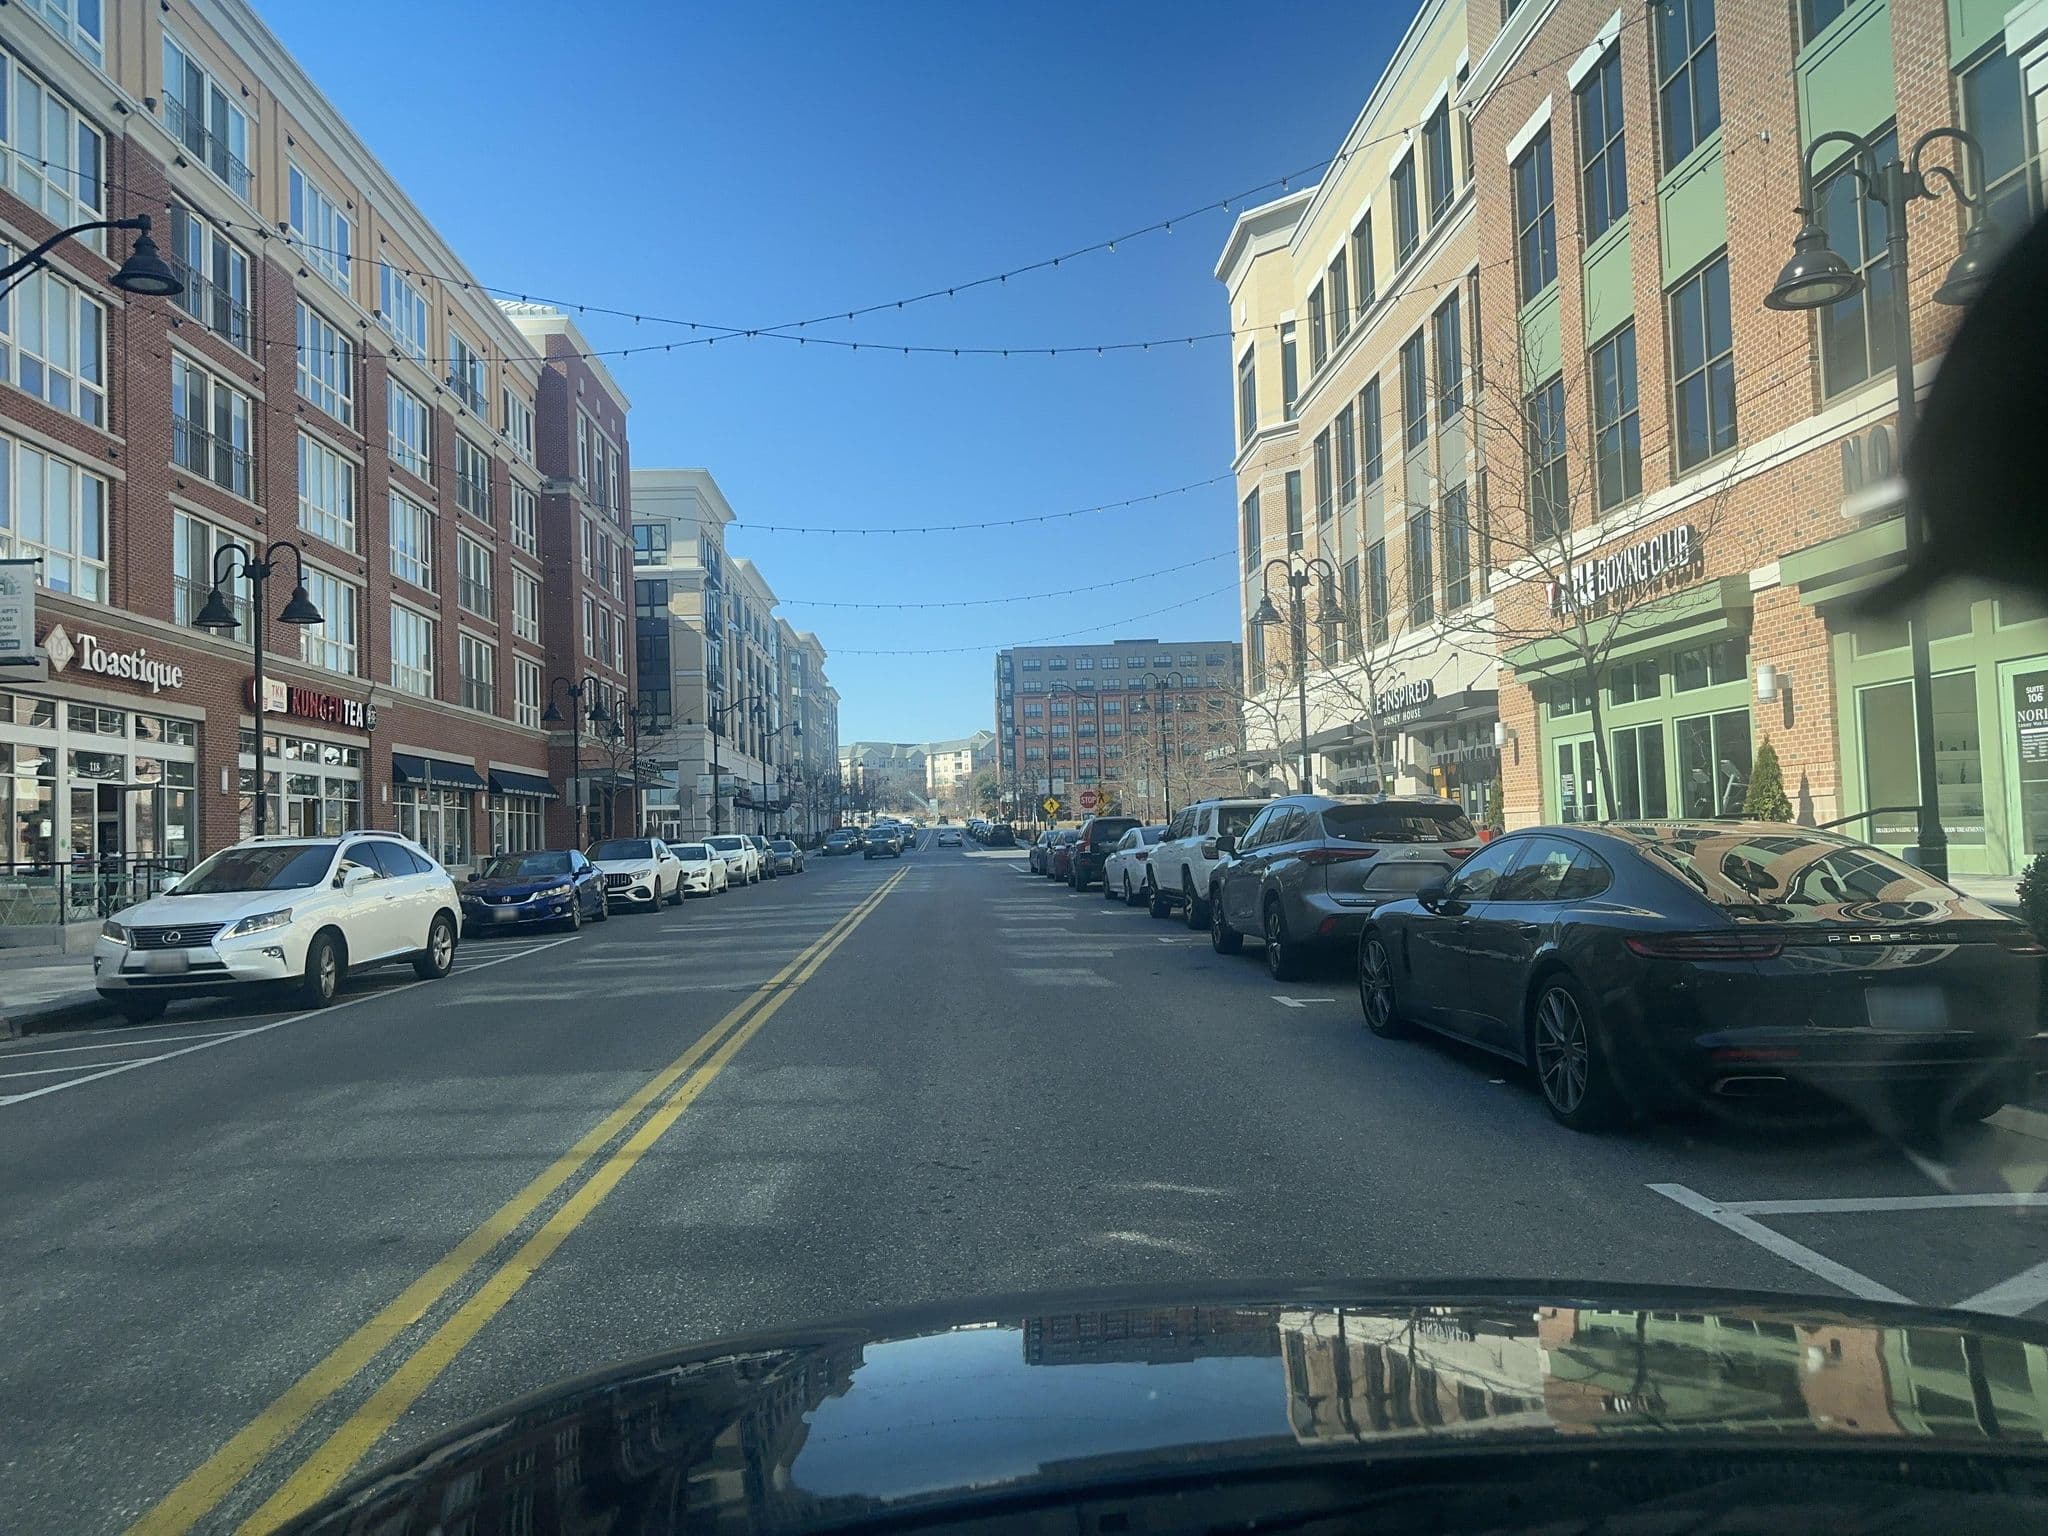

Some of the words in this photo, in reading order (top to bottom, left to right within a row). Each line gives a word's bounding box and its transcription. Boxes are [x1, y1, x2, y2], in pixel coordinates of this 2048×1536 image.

[1598, 543, 1647, 597] BOXING
[1650, 524, 1690, 576] CLUB
[77, 632, 183, 694] Toastique
[2026, 685, 2045, 694] SUITE
[1383, 680, 1429, 712] INSPIRED
[2027, 692, 2044, 703] 106
[344, 699, 364, 728] TEA
[1402, 708, 1422, 721] HOUSE
[89, 761, 101, 772] 118
[1081, 796, 1097, 804] STOP
[1827, 932, 1959, 943] PORSCHE
